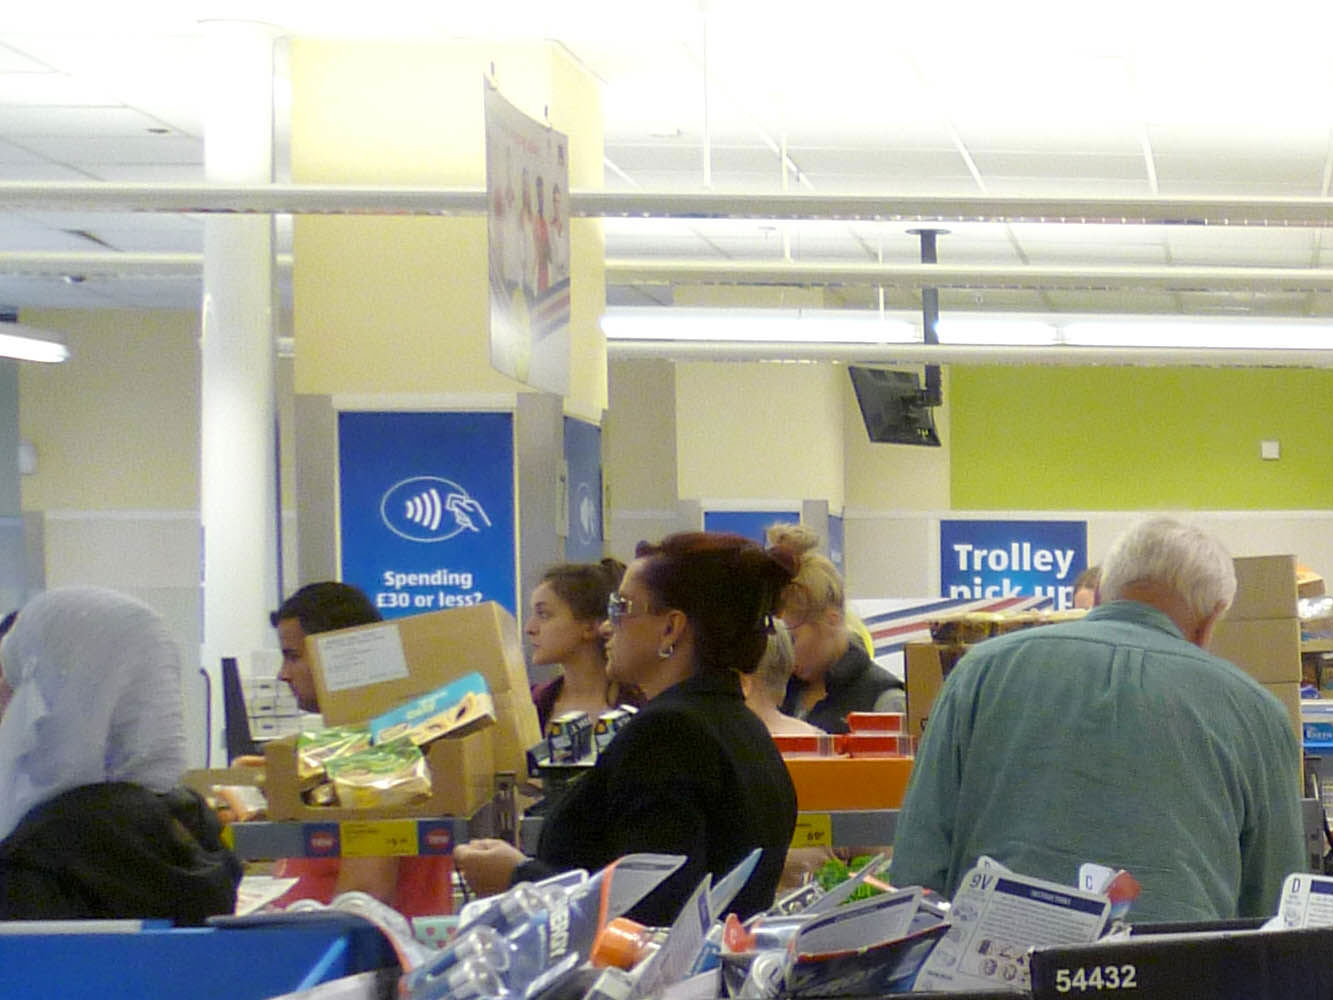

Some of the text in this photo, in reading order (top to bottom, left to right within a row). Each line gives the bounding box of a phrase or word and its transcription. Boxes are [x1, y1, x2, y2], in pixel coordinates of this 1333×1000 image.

[953, 542, 1075, 579] Trolley
[383, 569, 473, 590] Spending
[376, 591, 483, 608] £30 or less?
[967, 872, 991, 891] 9V
[1085, 874, 1094, 891] C
[1290, 877, 1301, 895] D
[1056, 964, 1137, 993] 54432
